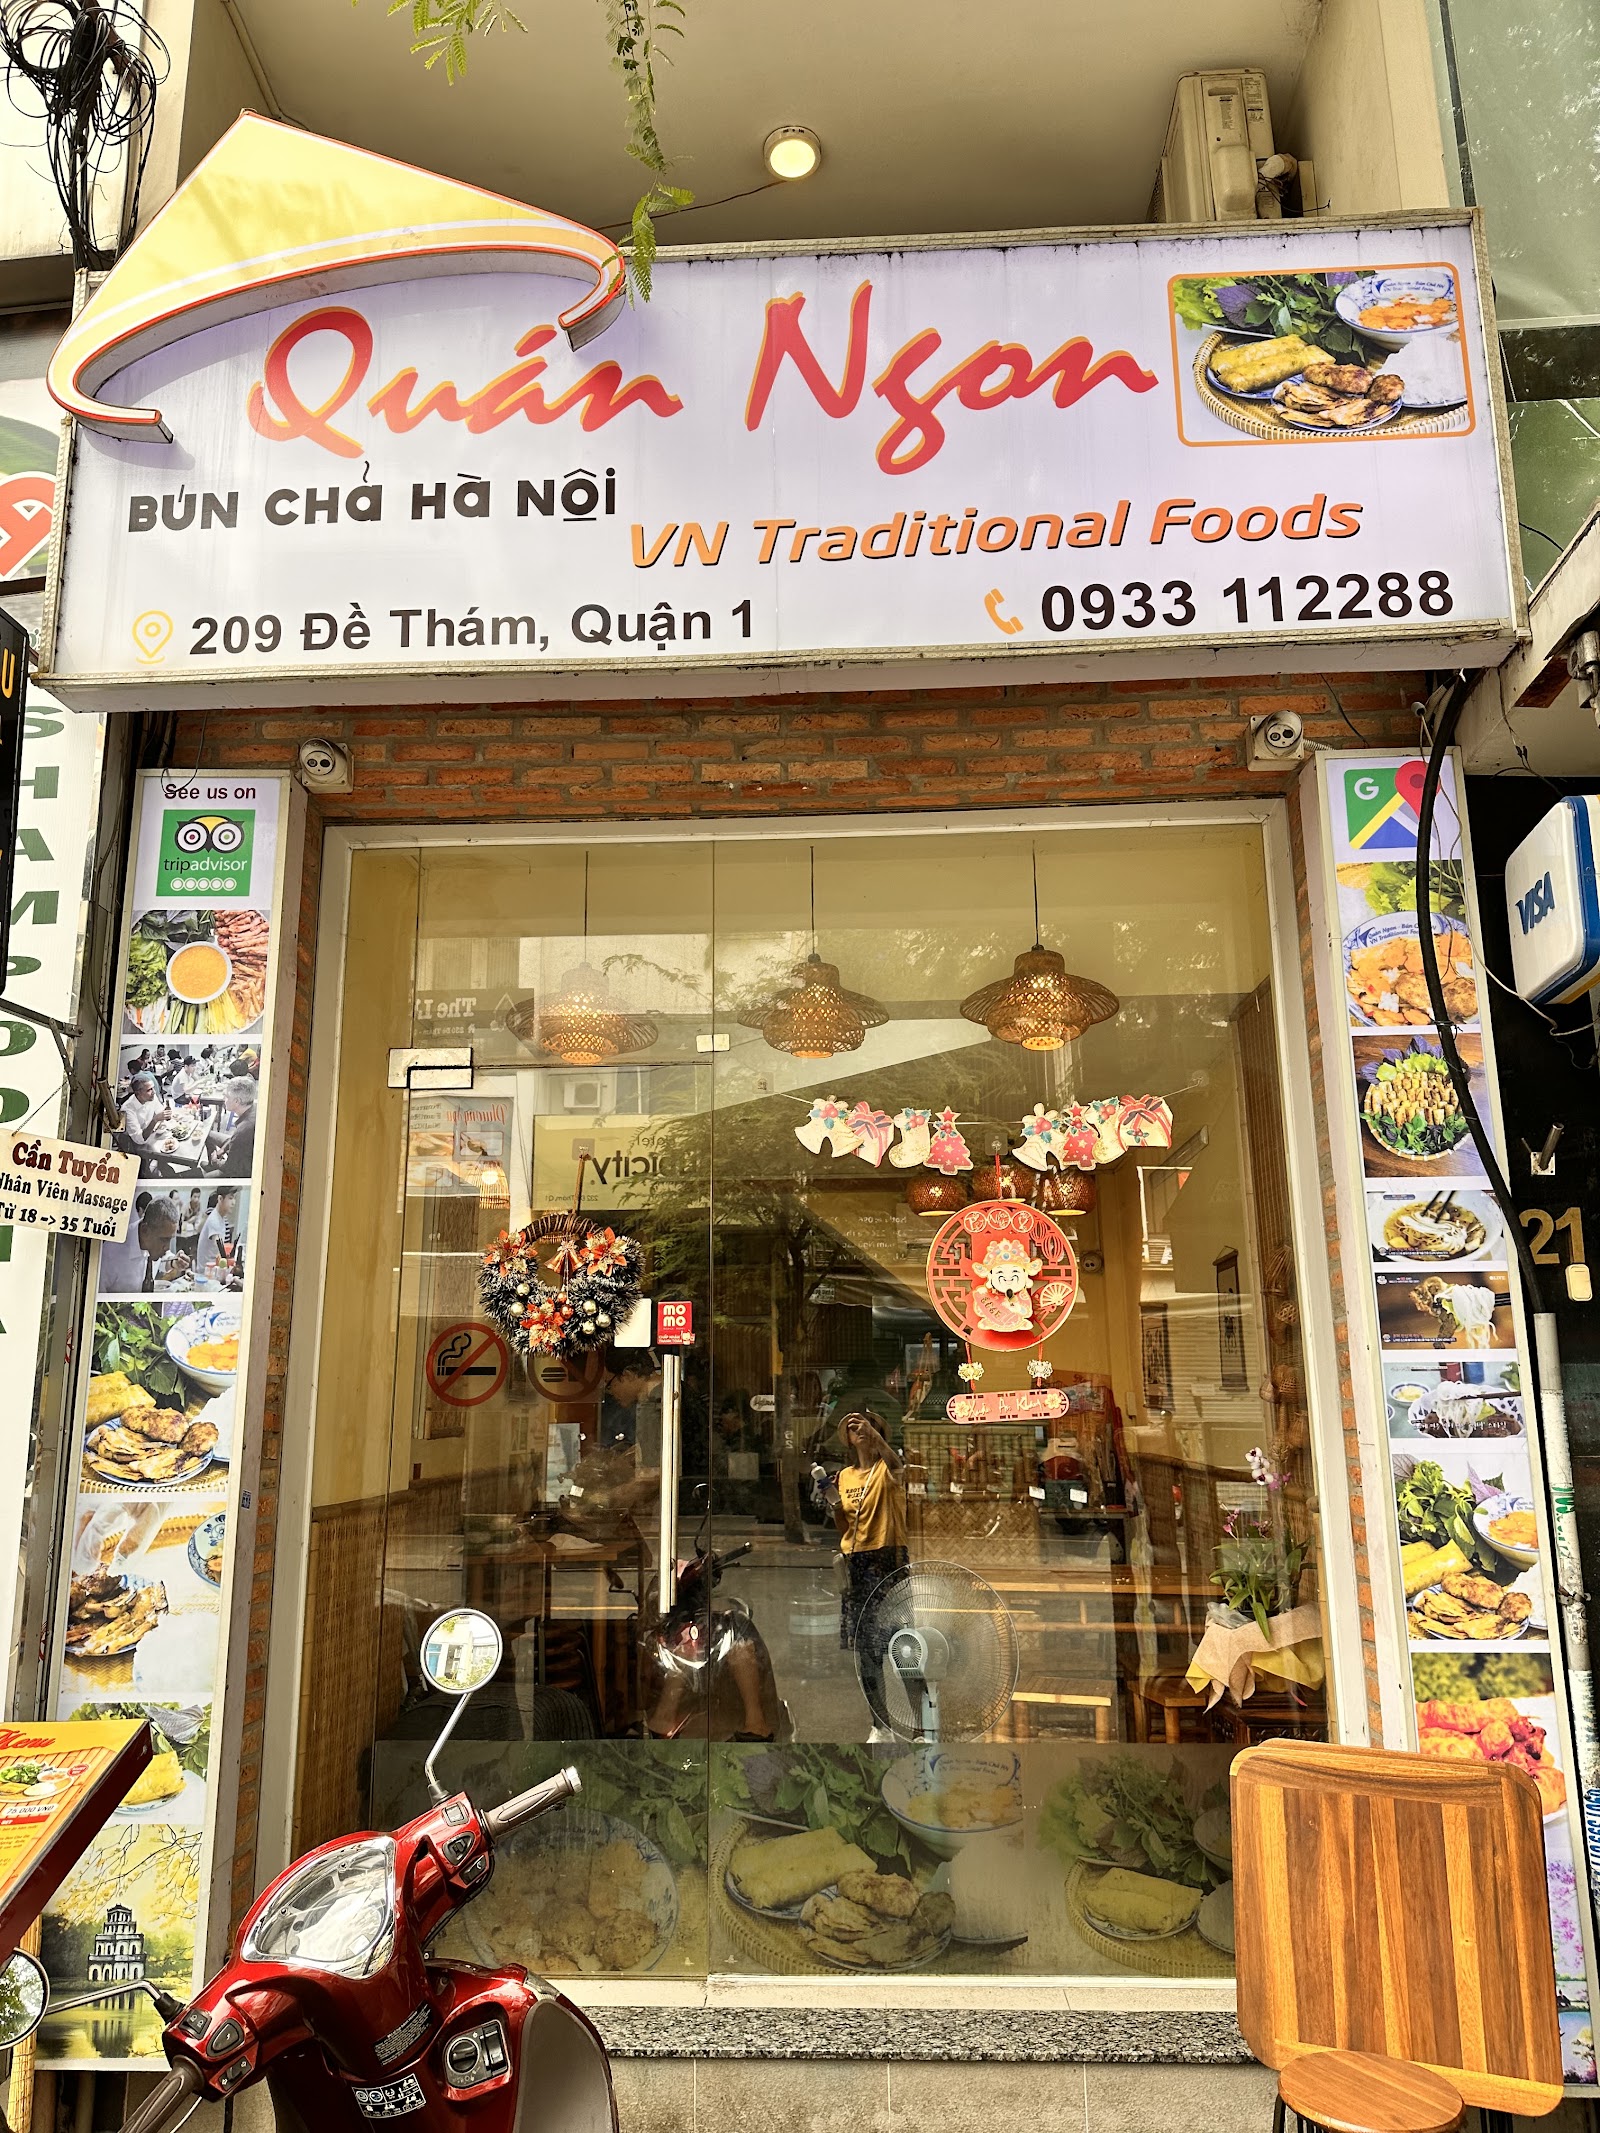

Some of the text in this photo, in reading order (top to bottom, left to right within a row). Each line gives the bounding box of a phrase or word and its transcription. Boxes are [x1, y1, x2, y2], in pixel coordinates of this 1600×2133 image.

[247, 278, 1159, 476] Quán Ngon
[127, 484, 239, 532] BÚN
[629, 492, 1364, 568] VN Traditional Foods
[1041, 570, 1454, 632] 0933 112288
[190, 600, 752, 655] 209 Đề Thám, Quận 1
[165, 784, 256, 799] See us on
[164, 857, 248, 874] tripadvisor
[1515, 871, 1555, 935] VISA
[12, 1139, 121, 1185] Cần Tuyển
[37, 1179, 69, 1201] Viên
[72, 1186, 128, 1214] Massage
[19, 1208, 37, 1223] 18
[60, 1215, 78, 1232] 35
[83, 1216, 117, 1237] Tuổi
[1519, 1207, 1586, 1265] 21
